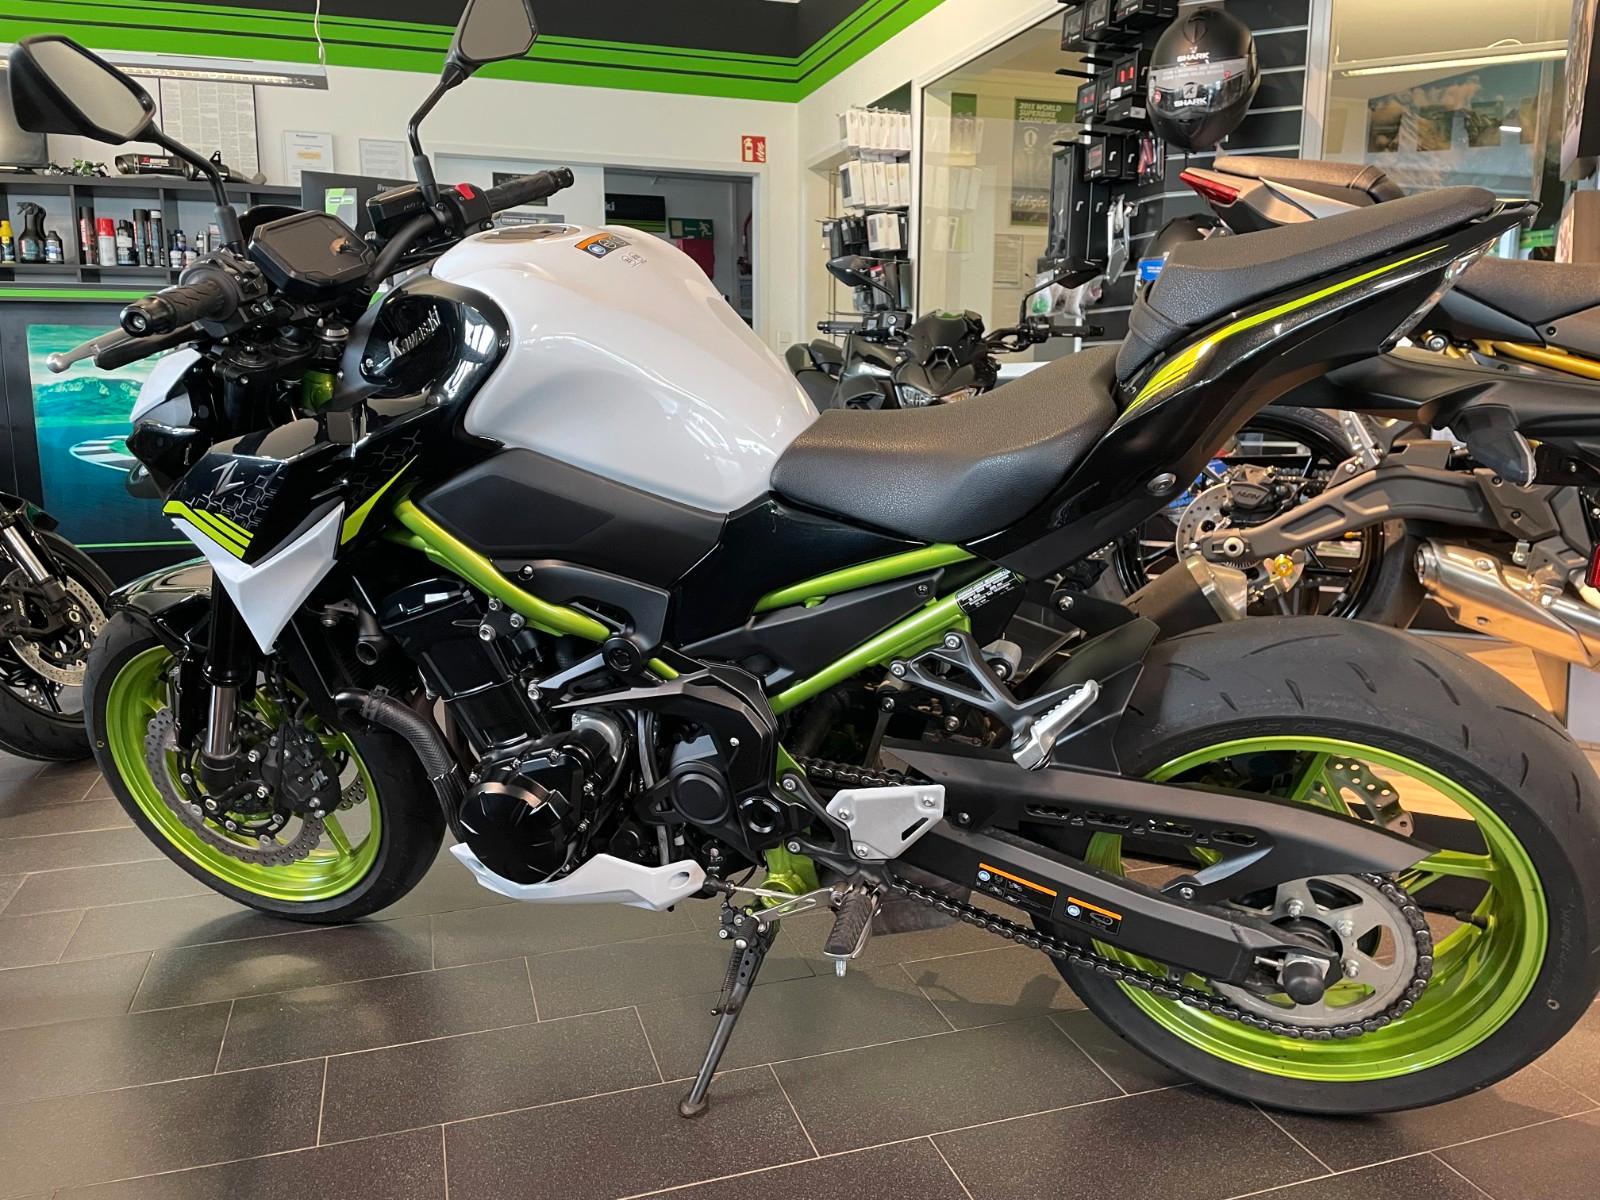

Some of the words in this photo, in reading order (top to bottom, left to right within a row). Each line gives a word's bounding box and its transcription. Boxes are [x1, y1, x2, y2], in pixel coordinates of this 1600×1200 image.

[1176, 52, 1210, 63] SHARK
[1036, 104, 1062, 112] WORLD
[1173, 97, 1207, 108] SHARK
[388, 304, 441, 360] Kawasaki
